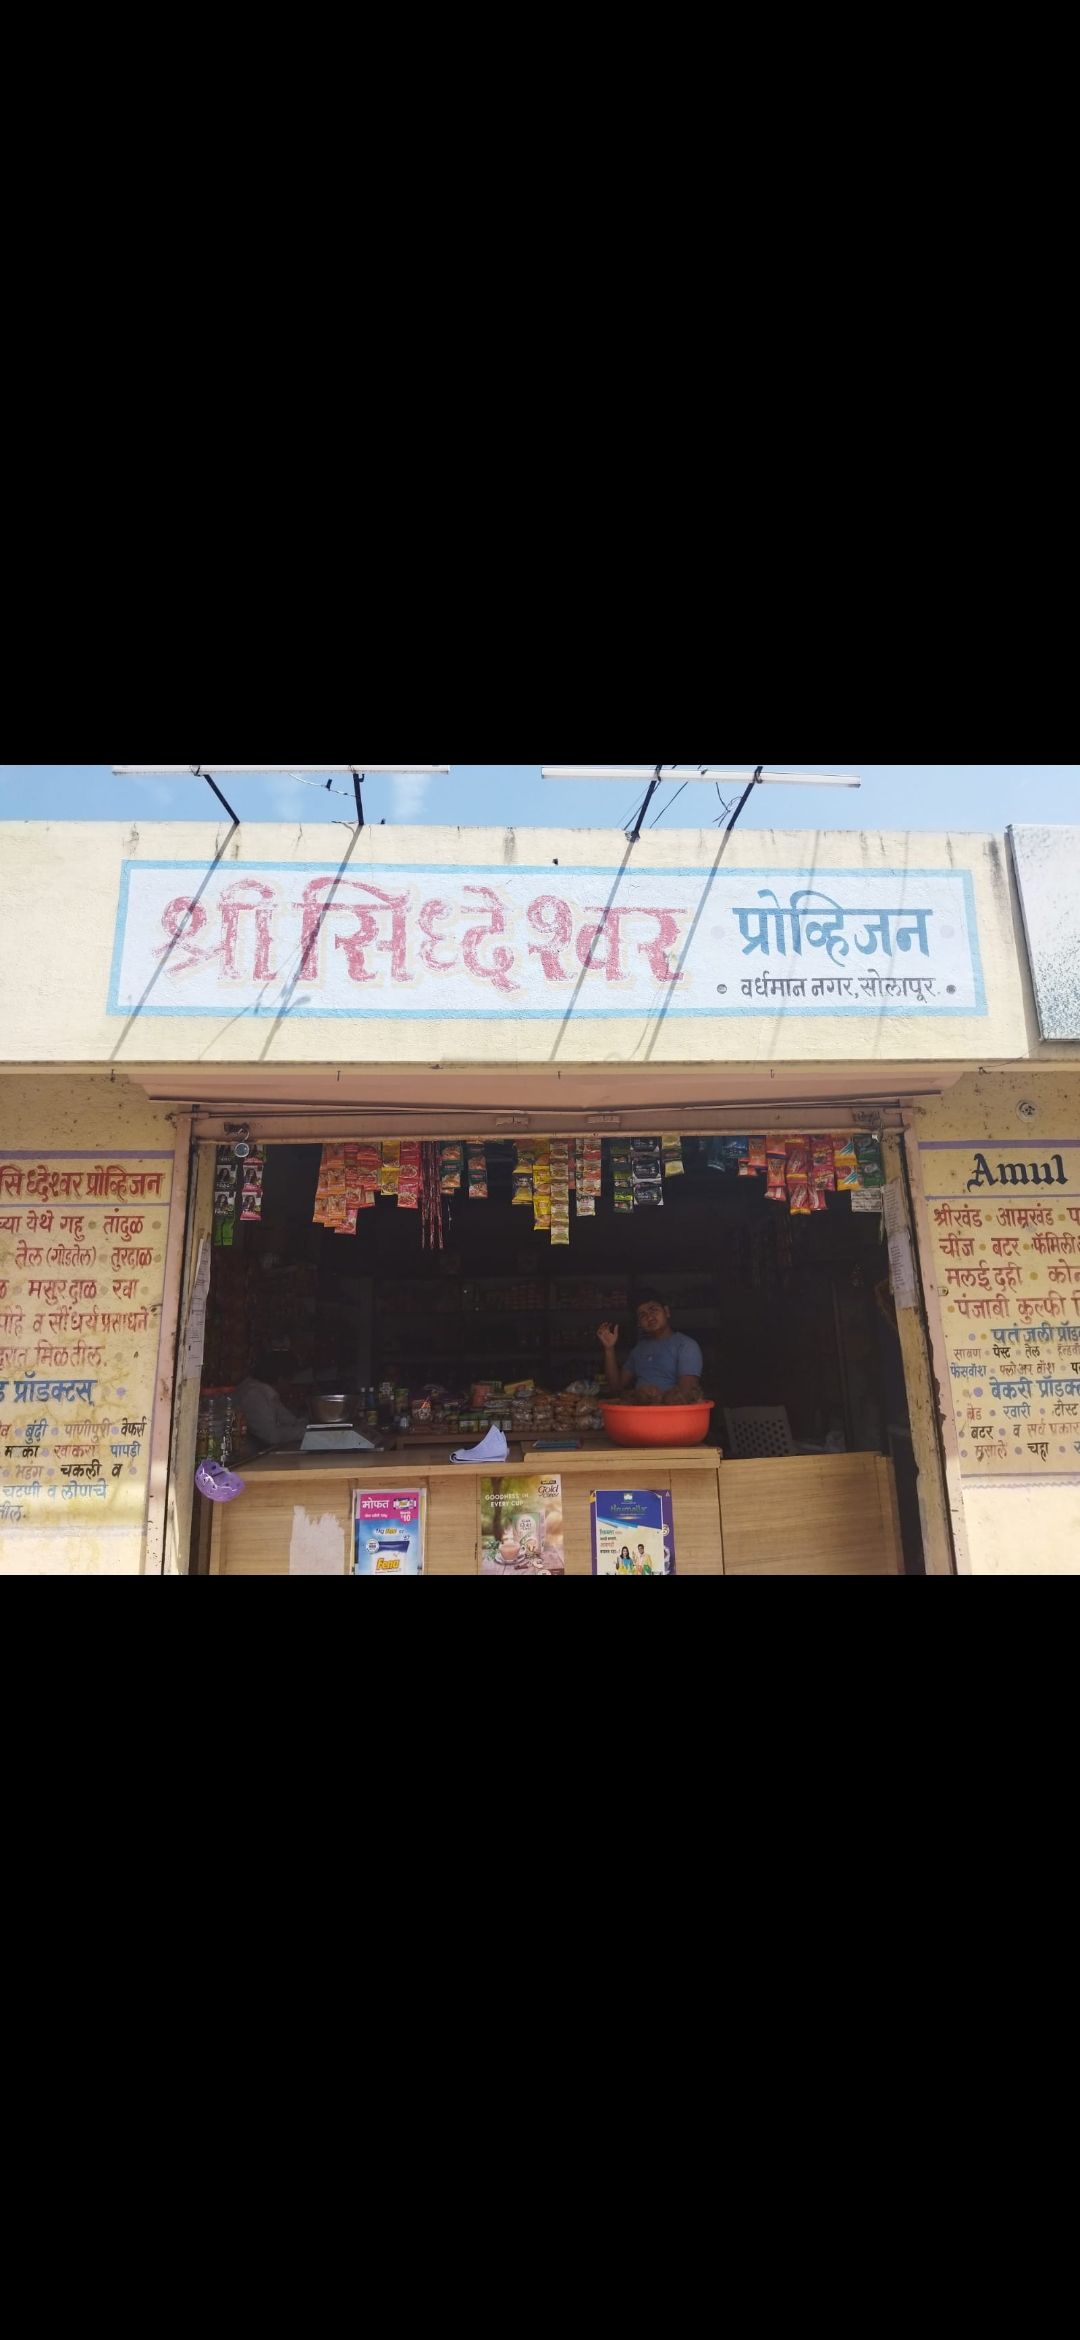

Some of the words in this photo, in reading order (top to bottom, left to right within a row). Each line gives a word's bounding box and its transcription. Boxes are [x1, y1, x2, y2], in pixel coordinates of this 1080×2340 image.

[732, 889, 933, 967] प्रोव्हिजन
[740, 970, 807, 998] वर्धमान
[86, 1165, 165, 1201] प्रोव्हिजन
[967, 1153, 1069, 1192] Amul
[27, 1210, 54, 1233] येथे
[934, 1203, 983, 1228] श्रीखंड
[15, 1239, 43, 1270] तेल
[991, 1238, 1020, 1257] बटर
[113, 1279, 139, 1299] रवा
[954, 1293, 1010, 1318] पंजाबी
[33, 1313, 45, 1333] व
[1025, 1344, 1040, 1359] तेल
[989, 1377, 1033, 1399] बेकरी
[971, 1426, 994, 1440] बटर
[1027, 1442, 1049, 1462] चहा
[60, 1459, 102, 1479] चकली
[112, 1463, 123, 1478] व
[361, 1497, 390, 1509] मोफत
